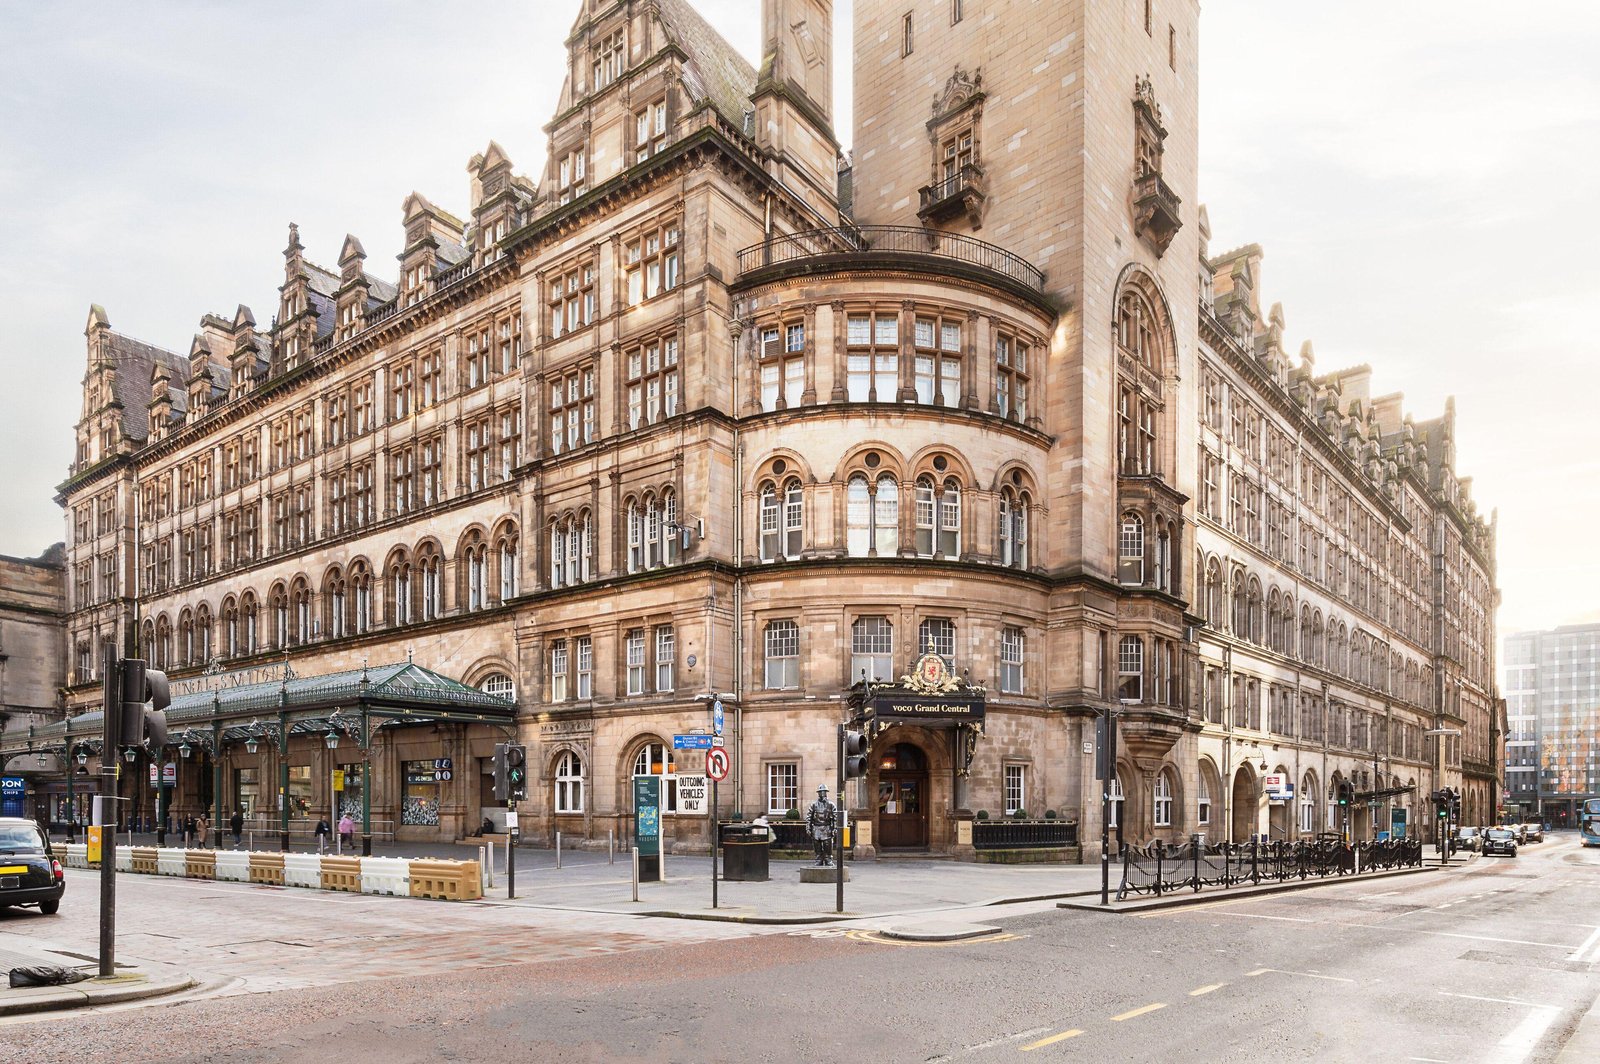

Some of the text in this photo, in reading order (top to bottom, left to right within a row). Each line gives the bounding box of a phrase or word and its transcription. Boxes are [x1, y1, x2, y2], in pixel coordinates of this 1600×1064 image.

[892, 703, 971, 713] voco Grand Central
[679, 776, 705, 787] OUTGOING
[679, 788, 705, 799] VEHICLES
[684, 800, 700, 810] ONLY
